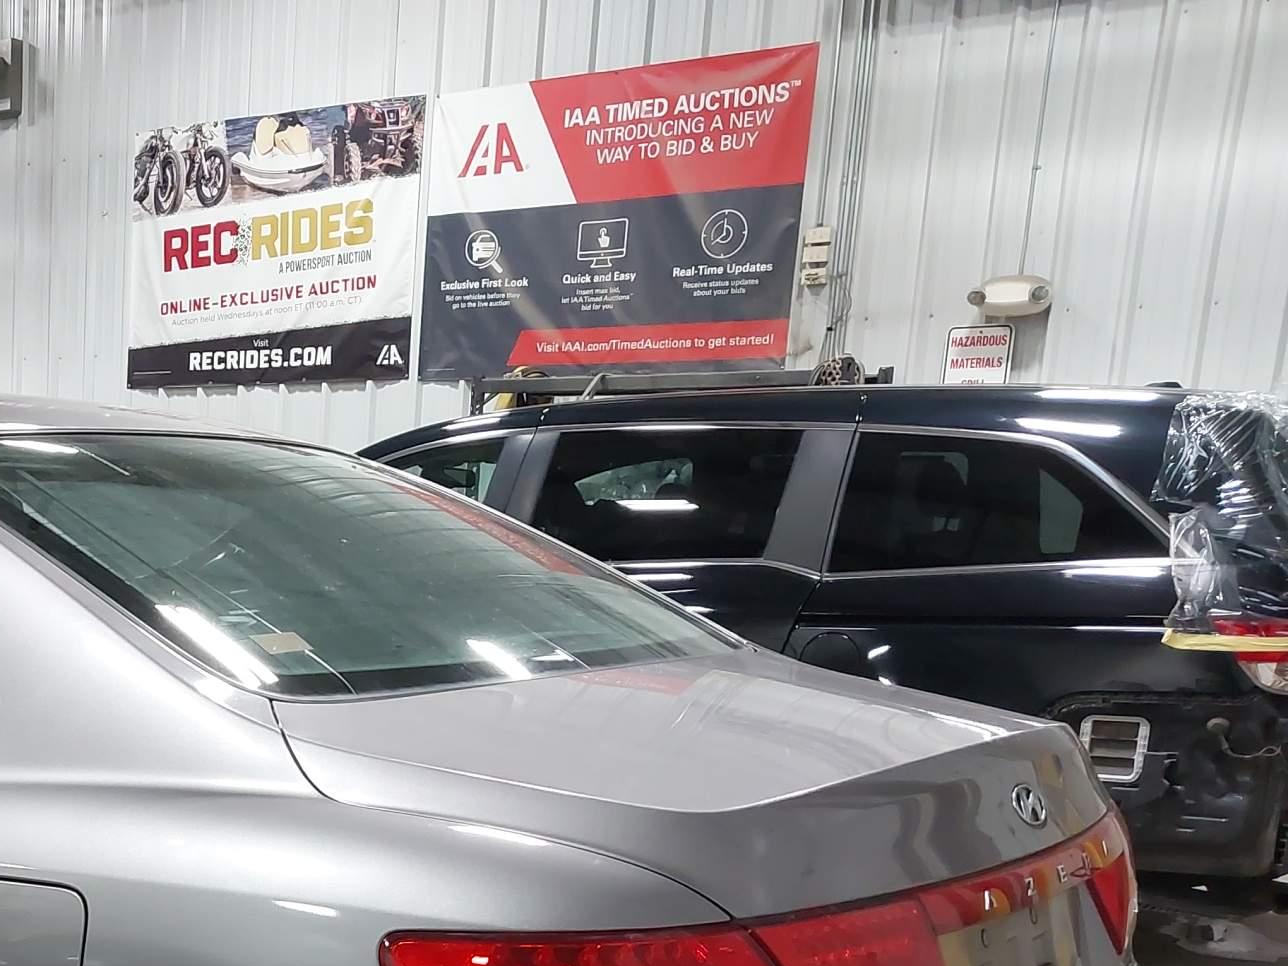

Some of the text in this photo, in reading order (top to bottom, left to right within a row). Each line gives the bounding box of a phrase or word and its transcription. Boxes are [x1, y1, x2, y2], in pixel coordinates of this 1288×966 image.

[564, 106, 600, 129] IAA
[605, 97, 668, 125] TIMED
[585, 108, 774, 146] INTRODUCING A NEW
[596, 131, 760, 165] WAY TO BID & BUY
[163, 198, 374, 272] REC RIDES
[278, 248, 372, 274] A POWERSPORT AUCTION
[672, 262, 774, 277] Real-Time Updates
[440, 276, 529, 291] Exclusive First Look
[562, 270, 637, 284] Quick and Easy
[160, 274, 377, 316] ONLINE-EXCLUSIVE AUCTION
[171, 317, 199, 326] Auction
[252, 338, 270, 348] Visit
[536, 333, 775, 353] Visit IAAI.com/TimedAuctions to get started!
[951, 334, 1008, 348] HAZARDOUS
[188, 346, 333, 372] RECRIDES.COM
[949, 356, 1004, 370] MATERIALS
